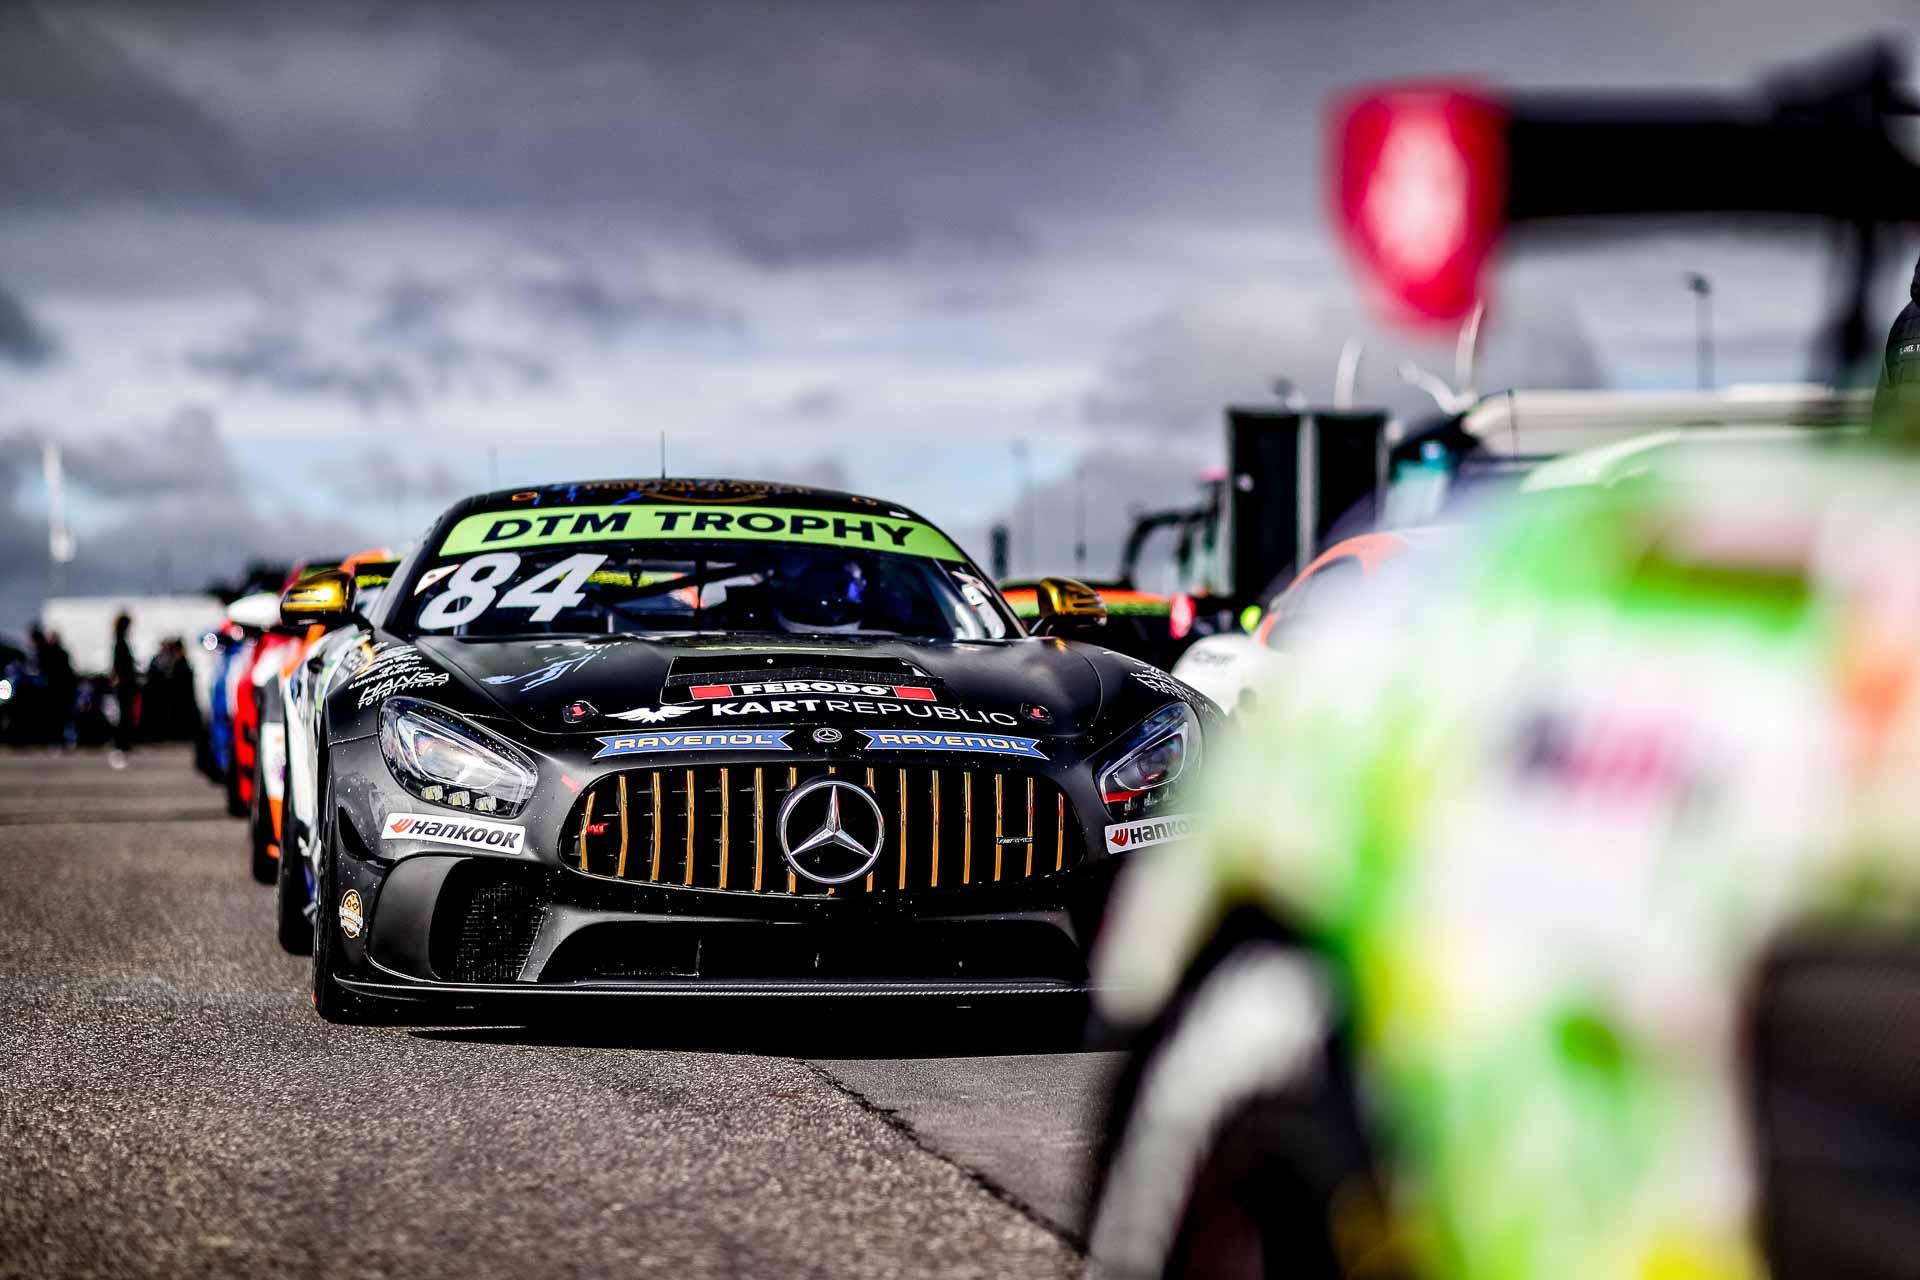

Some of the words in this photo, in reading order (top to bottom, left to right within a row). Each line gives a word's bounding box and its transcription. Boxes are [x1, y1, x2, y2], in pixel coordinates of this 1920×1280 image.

[482, 512, 631, 542] DTM
[655, 512, 914, 546] TROPHY
[418, 552, 608, 630] 84
[360, 672, 449, 703] HANSA
[742, 682, 884, 695] FERODO
[614, 735, 773, 750] RAVENOL
[880, 735, 1030, 751] RAVENOL
